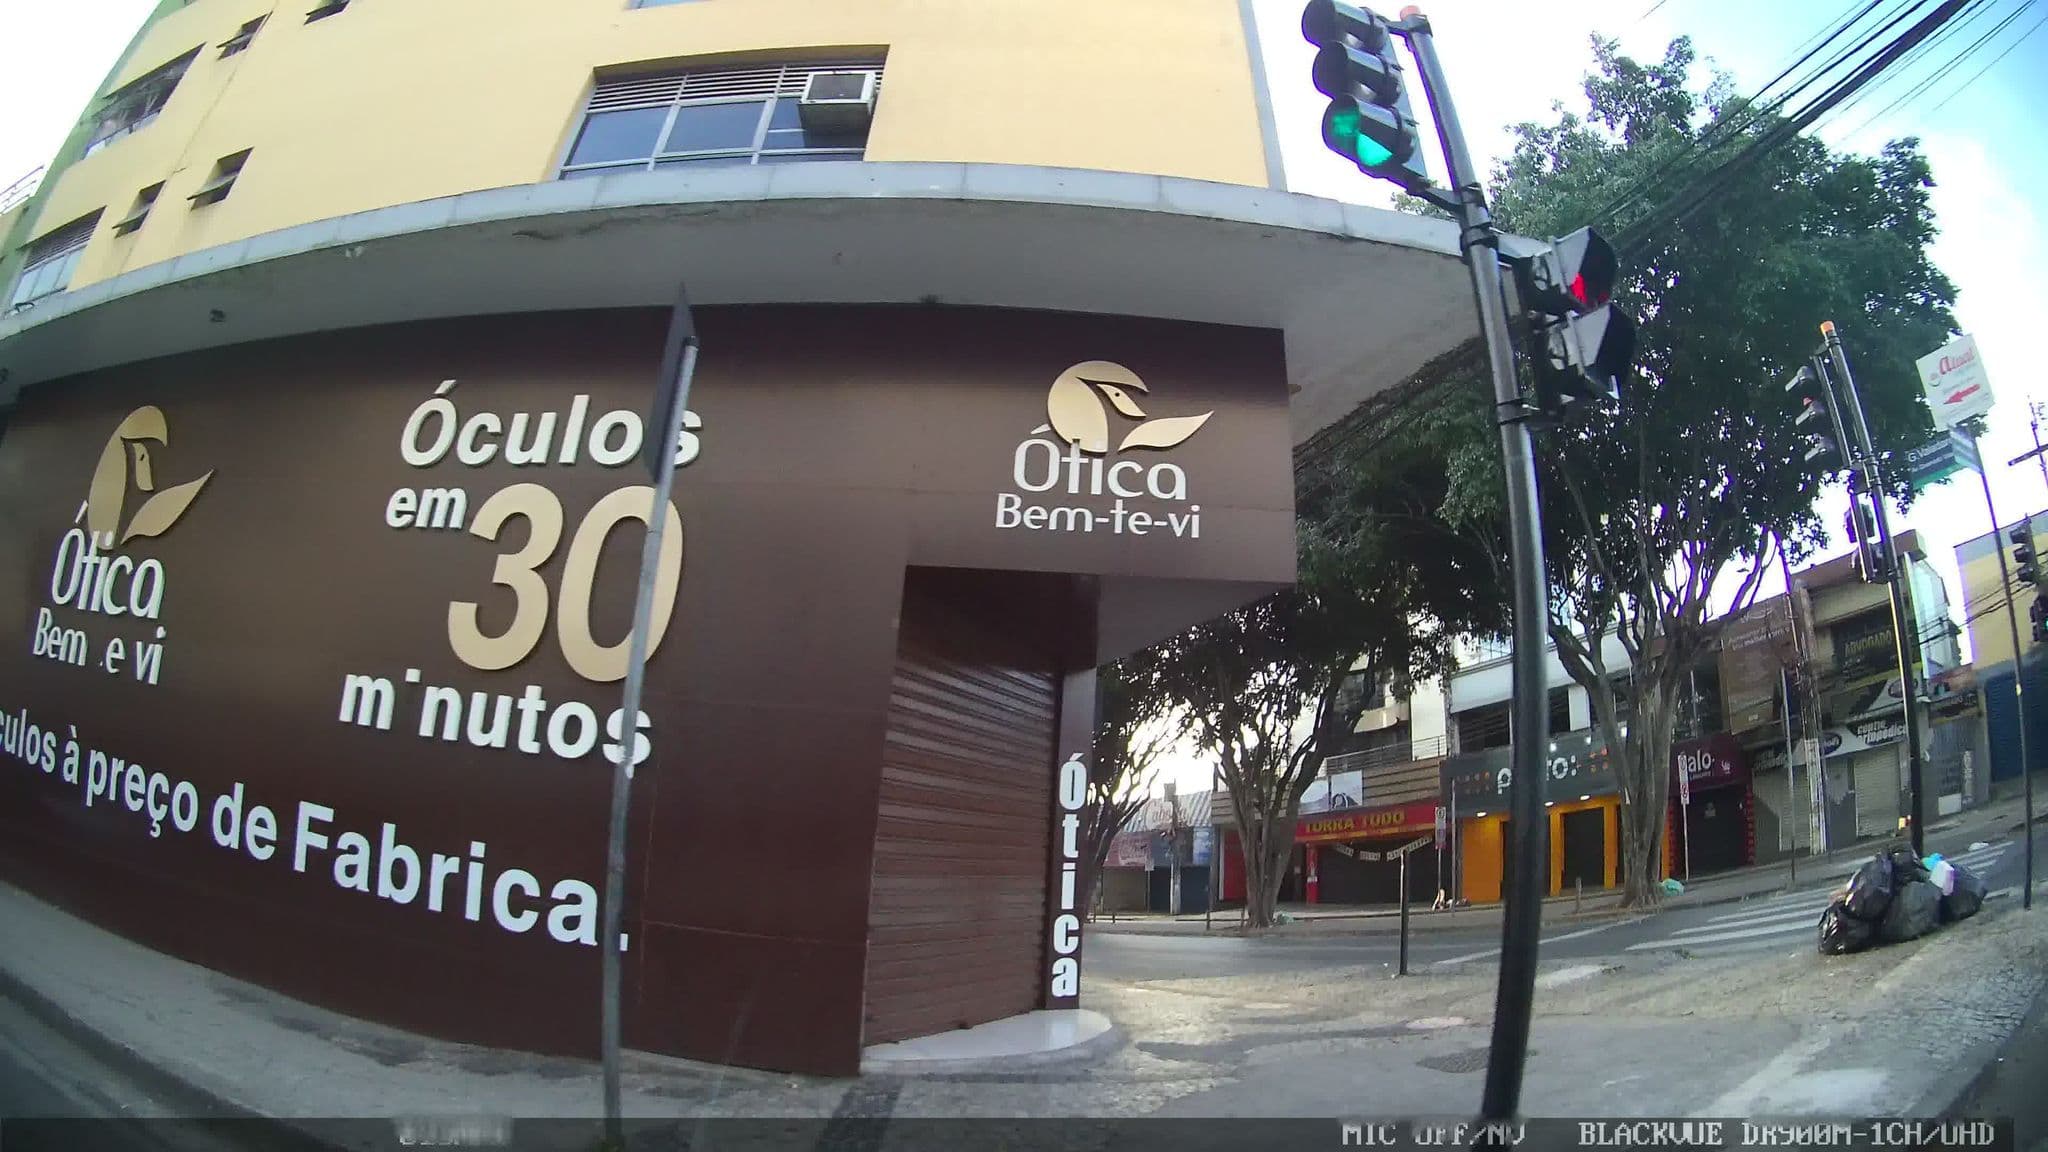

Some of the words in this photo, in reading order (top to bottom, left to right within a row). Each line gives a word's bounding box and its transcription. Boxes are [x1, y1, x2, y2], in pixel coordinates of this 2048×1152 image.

[1013, 423, 1187, 500] Ótica
[51, 500, 165, 619] Ótica
[995, 492, 1200, 538] Bem-te-vi
[386, 486, 467, 528] em
[448, 482, 684, 682] 30
[32, 606, 87, 667] Bem
[136, 626, 167, 685] vi
[339, 667, 652, 766] mnutos
[63, 724, 80, 785] à
[86, 748, 199, 838] preço
[211, 782, 279, 861] de
